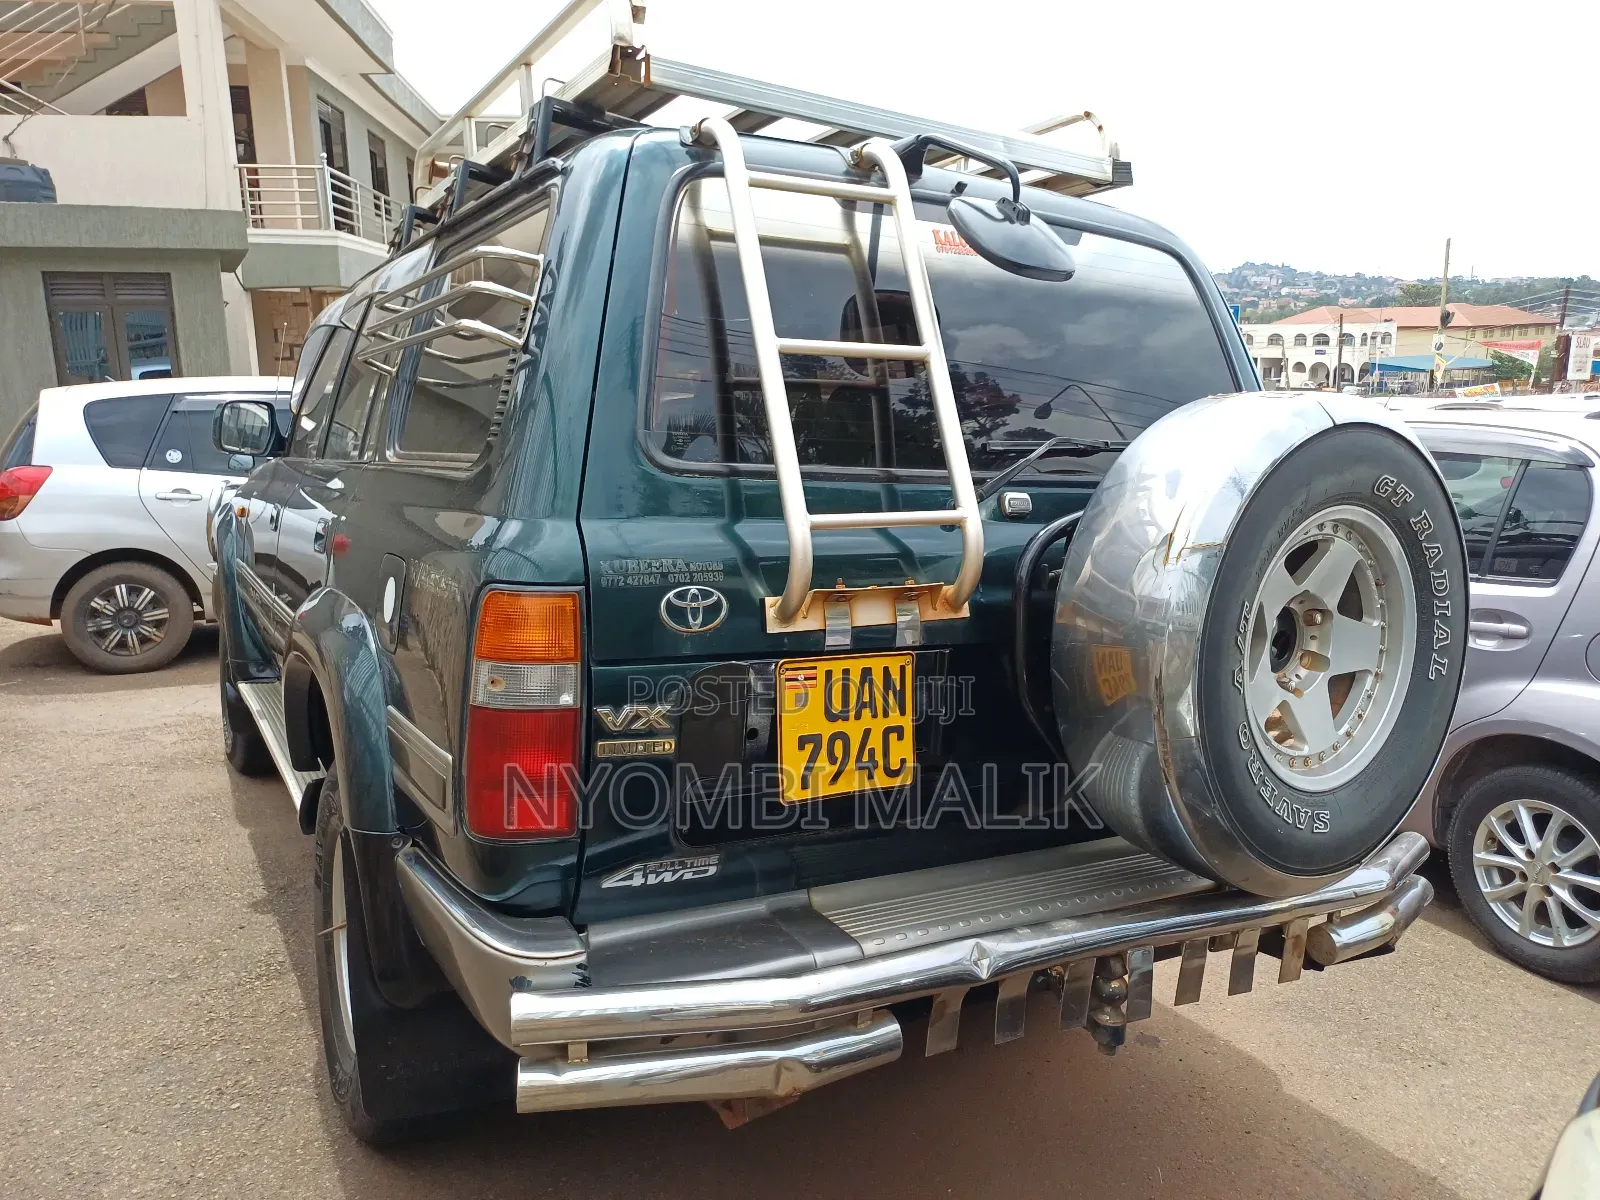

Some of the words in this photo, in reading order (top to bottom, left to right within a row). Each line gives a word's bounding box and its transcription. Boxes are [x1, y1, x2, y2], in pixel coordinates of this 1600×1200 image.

[601, 575, 625, 587] 0772
[626, 573, 660, 586] 427847
[668, 572, 690, 583] 0702
[689, 561, 723, 572] MOTORS
[1374, 474, 1415, 508] GT
[1409, 509, 1452, 681] RADIAL
[824, 664, 907, 723] UAN
[594, 705, 674, 731] VX
[601, 740, 674, 756] LIMITED
[797, 724, 908, 791] 794C
[1238, 721, 1331, 833] SAVERO
[601, 861, 718, 889] 4WD
[646, 860, 683, 873] FULL
[685, 855, 721, 868] TIME
